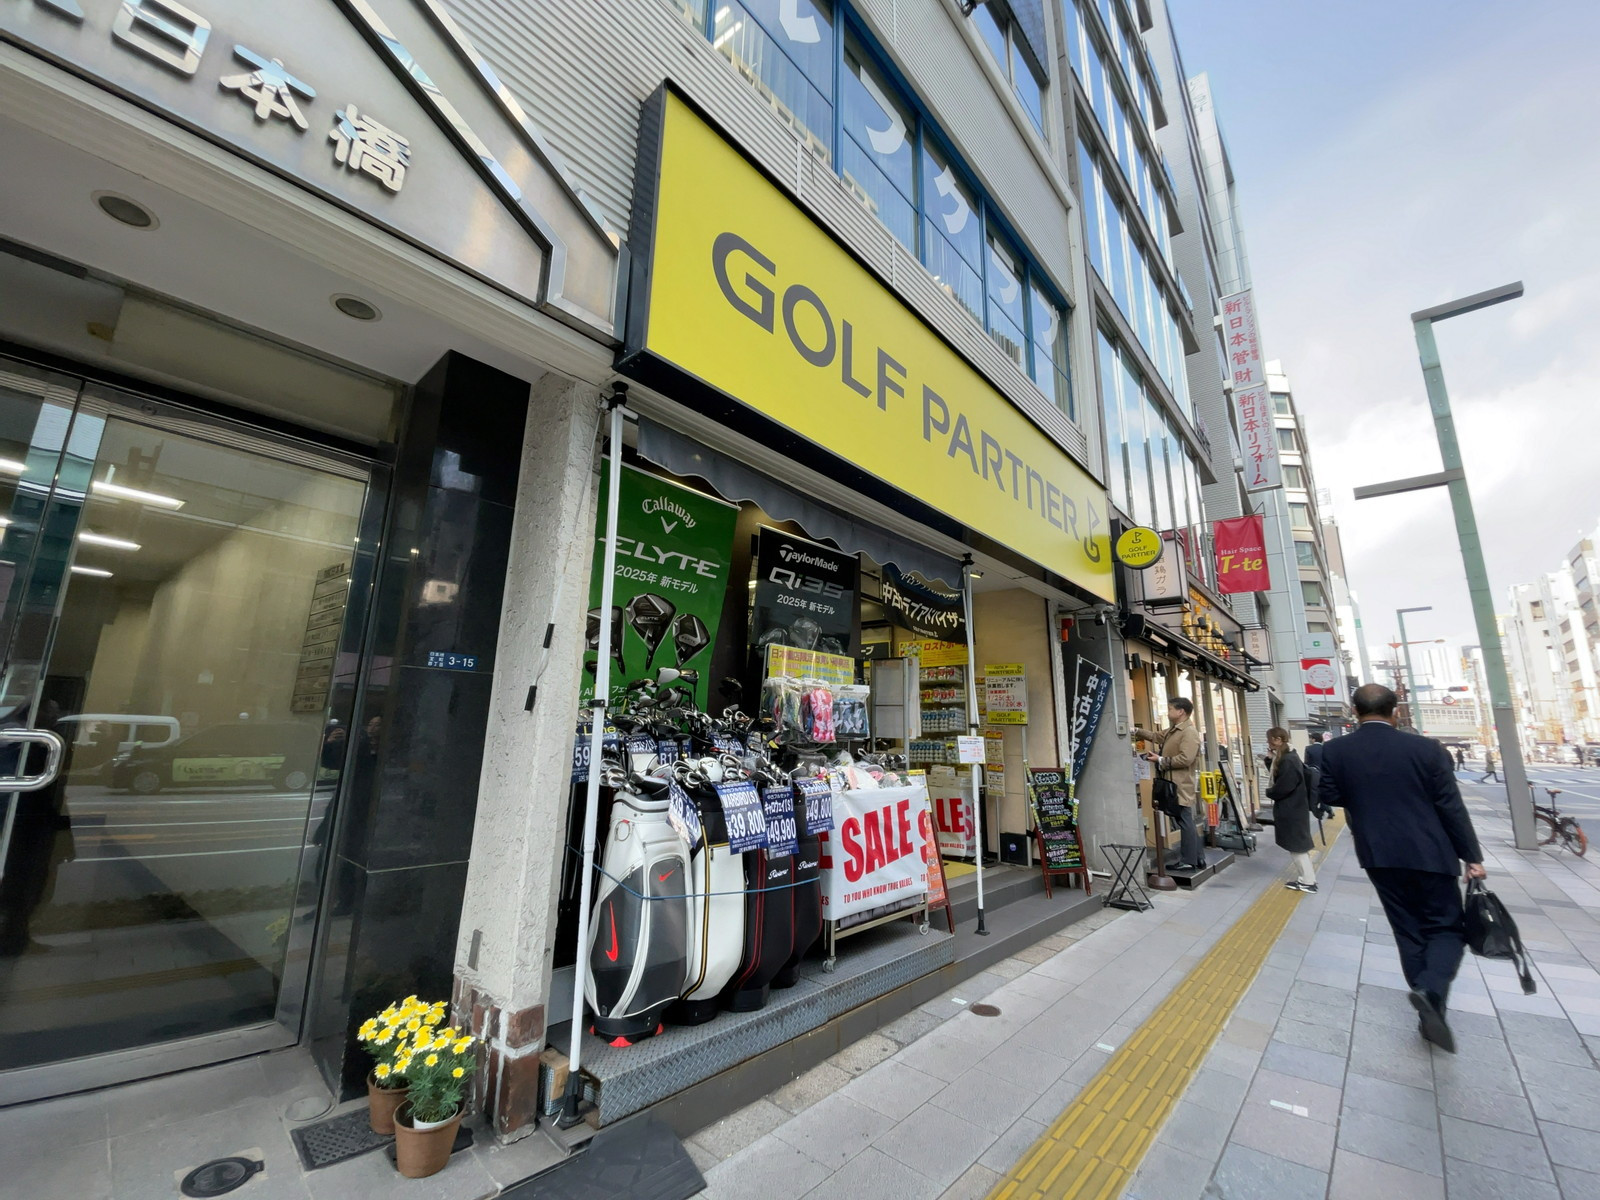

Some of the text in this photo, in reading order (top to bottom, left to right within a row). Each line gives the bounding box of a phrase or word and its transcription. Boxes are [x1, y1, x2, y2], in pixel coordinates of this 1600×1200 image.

[35, 0, 412, 194] 日本橋
[1223, 298, 1253, 385] 新日本管財
[711, 231, 1080, 543] GOLF PARTNER
[1238, 392, 1268, 486] 新日本リフォーム
[642, 496, 697, 529] Callaway
[597, 534, 721, 579] ELYTE
[779, 545, 838, 572] TaylorMade
[1121, 550, 1156, 560] PARTNER
[1128, 545, 1148, 553] GOLF
[1220, 546, 1262, 556] Hair Space
[614, 565, 699, 594] 2025年 新モデル
[1221, 555, 1264, 575] T-te
[769, 567, 844, 599] Qi35
[776, 594, 836, 616] 2025年 新モデル
[448, 656, 475, 668] 3-15
[725, 809, 766, 839] ¥39,800
[766, 817, 797, 844] ¥49,980
[841, 799, 914, 883] SALE
[844, 877, 913, 904] TO YOU WHO KNOW TRUE VALUES
